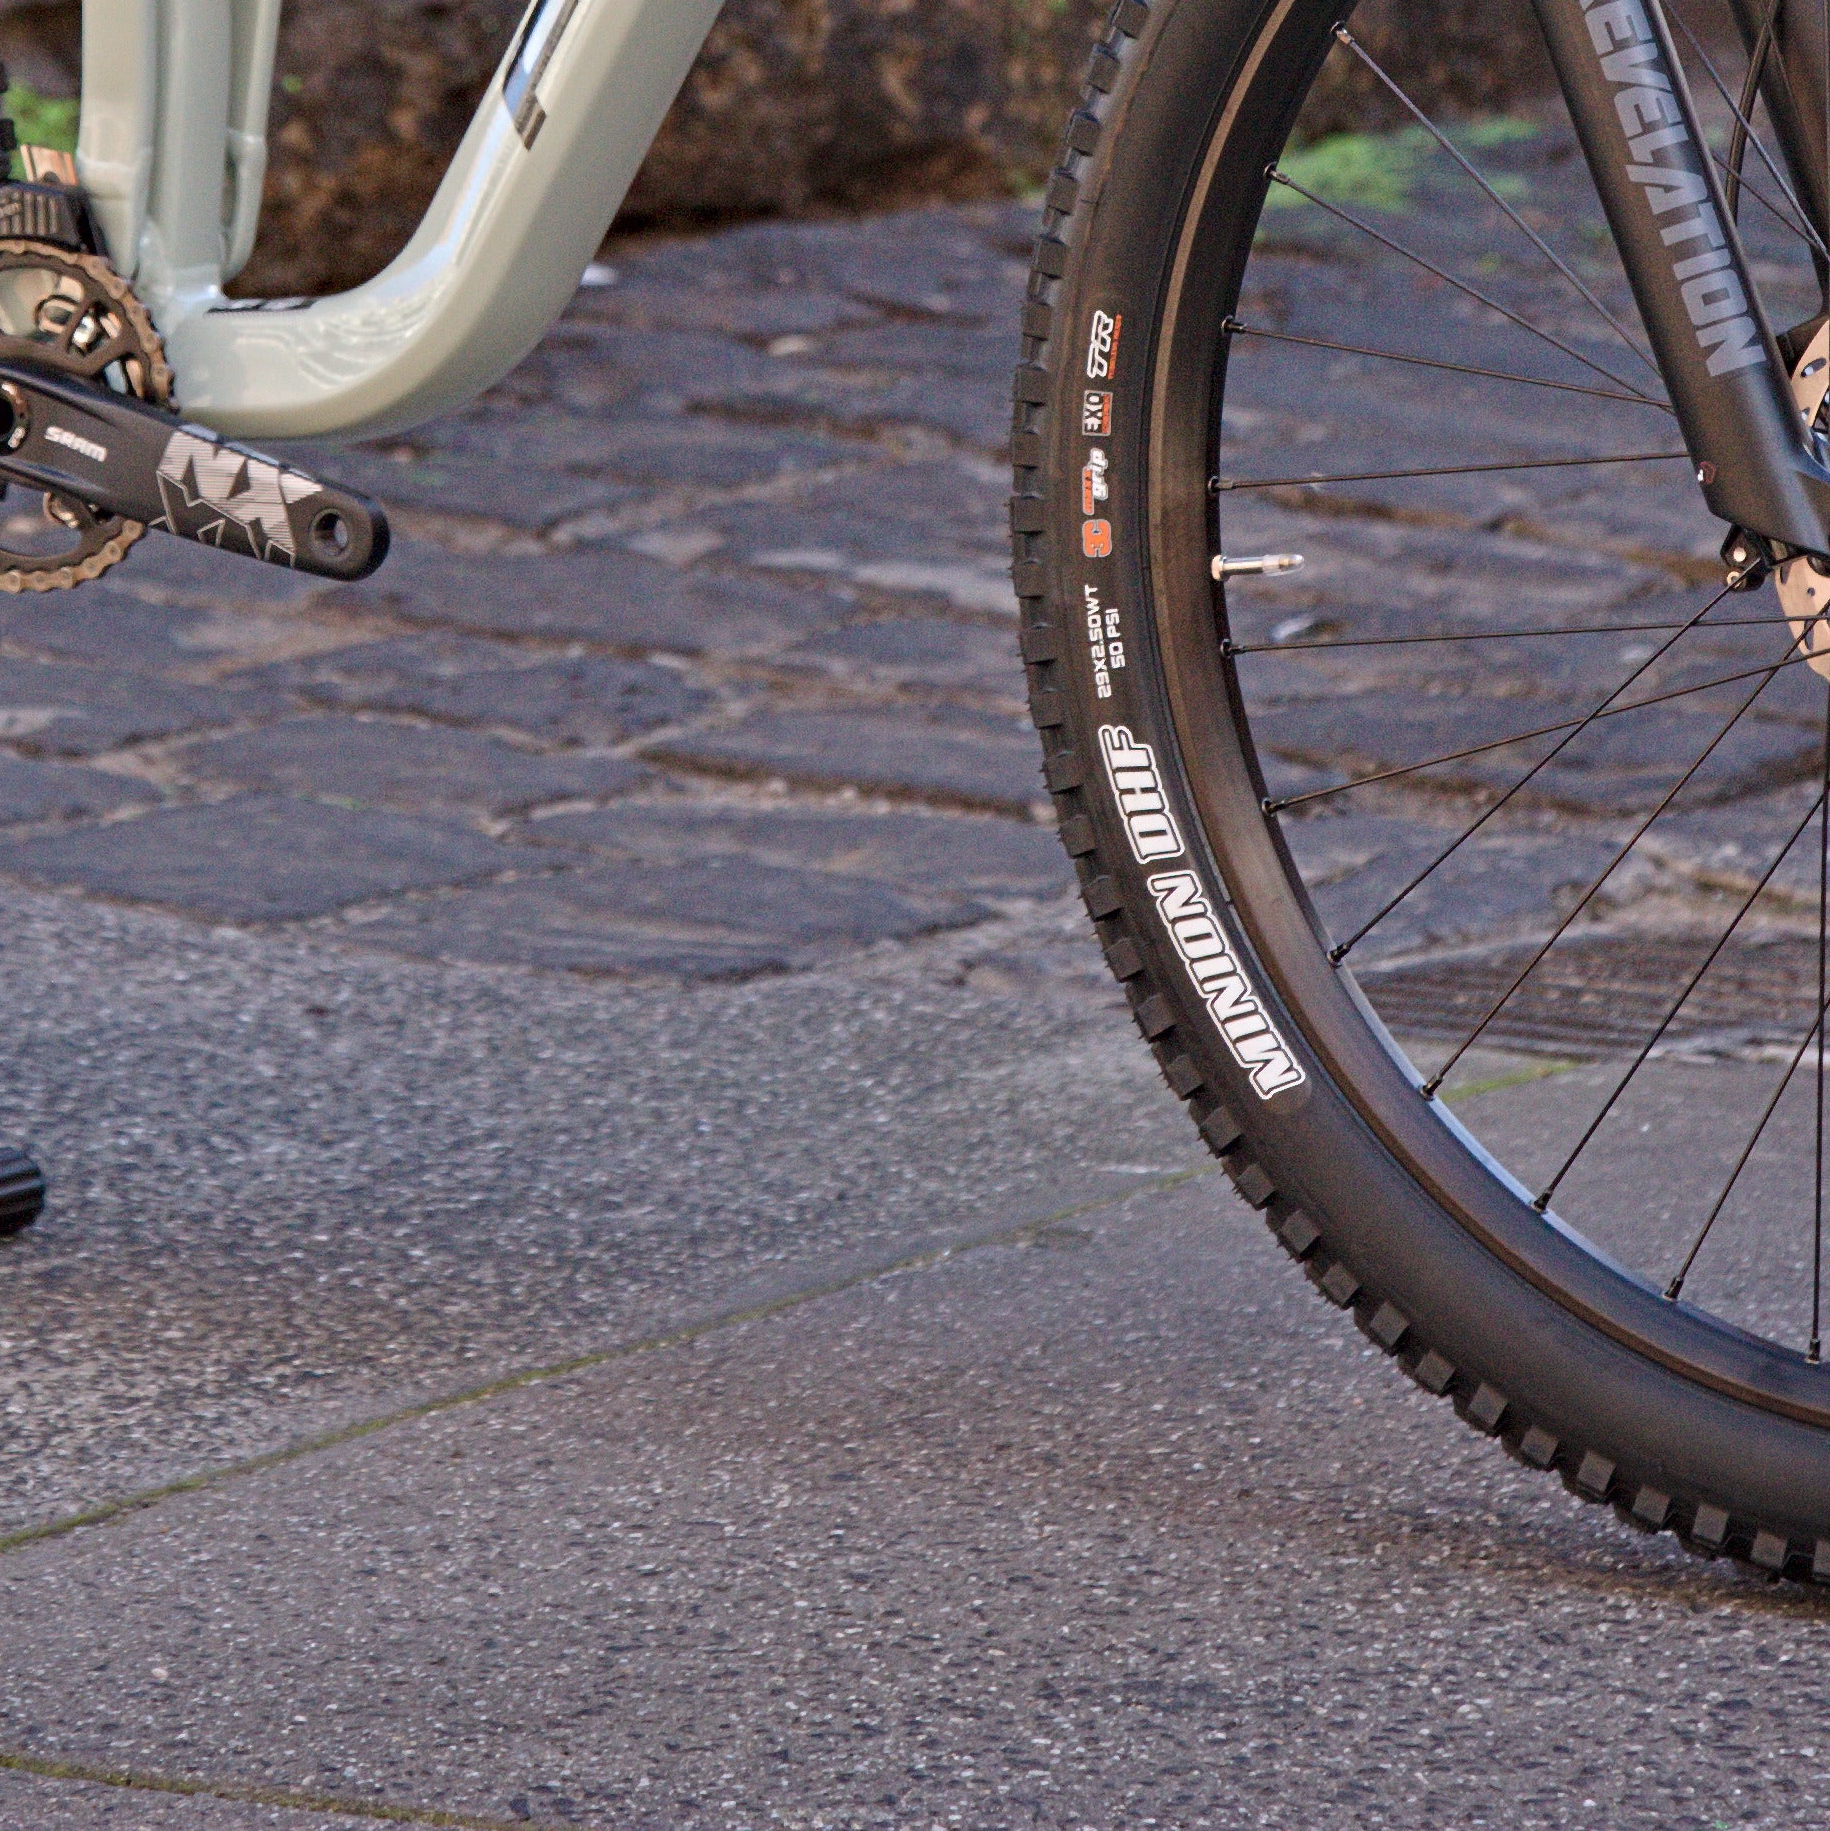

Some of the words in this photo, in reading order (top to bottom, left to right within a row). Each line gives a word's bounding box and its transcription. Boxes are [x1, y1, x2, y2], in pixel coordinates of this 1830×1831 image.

[1084, 392, 1103, 433] EXO
[1084, 584, 1112, 699] 29X2.50WT
[1105, 608, 1121, 638] PSI
[1109, 641, 1126, 669] 50
[1099, 724, 1185, 863] DHF
[1147, 870, 1306, 1101] MINION
